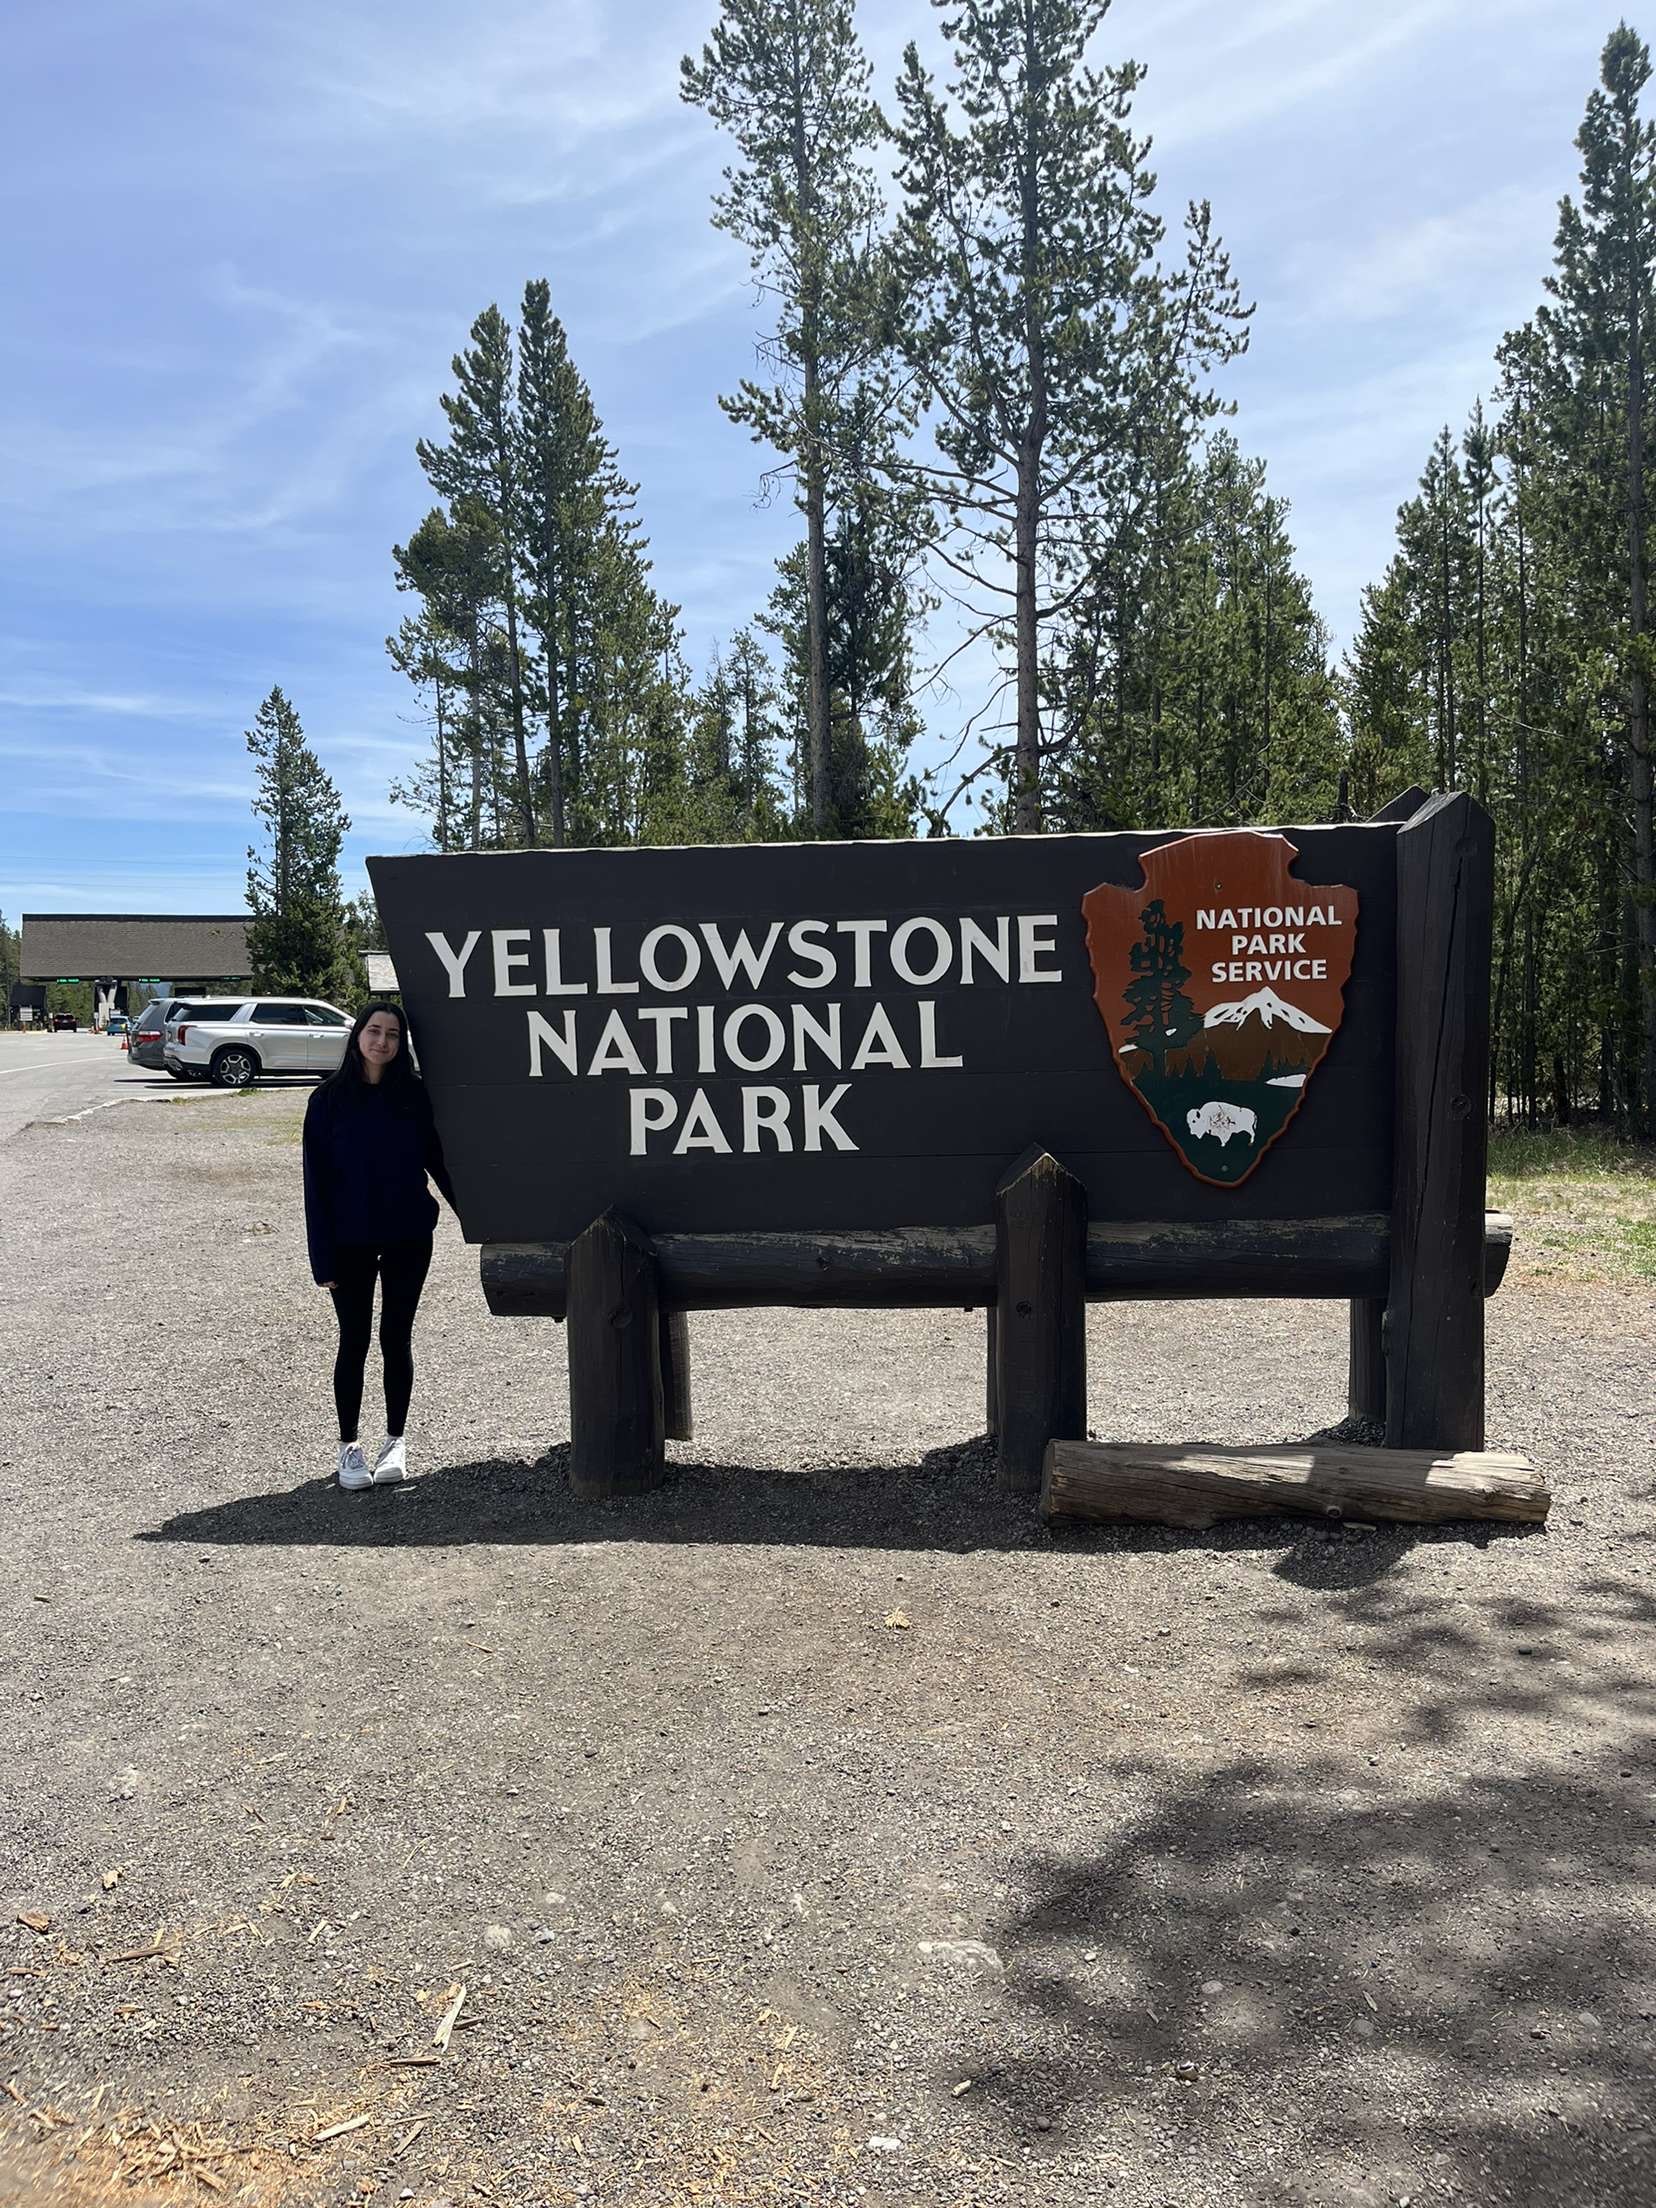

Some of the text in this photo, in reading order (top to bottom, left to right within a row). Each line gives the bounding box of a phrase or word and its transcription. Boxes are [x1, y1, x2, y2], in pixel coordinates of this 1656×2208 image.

[1196, 905, 1343, 930] NATIONAL
[425, 914, 1063, 998] YELLOWSTONE
[1231, 932, 1307, 955] PARK
[1211, 959, 1328, 983] SERVICE
[526, 1000, 964, 1077] NATIONAL
[628, 1084, 860, 1156] PARK
